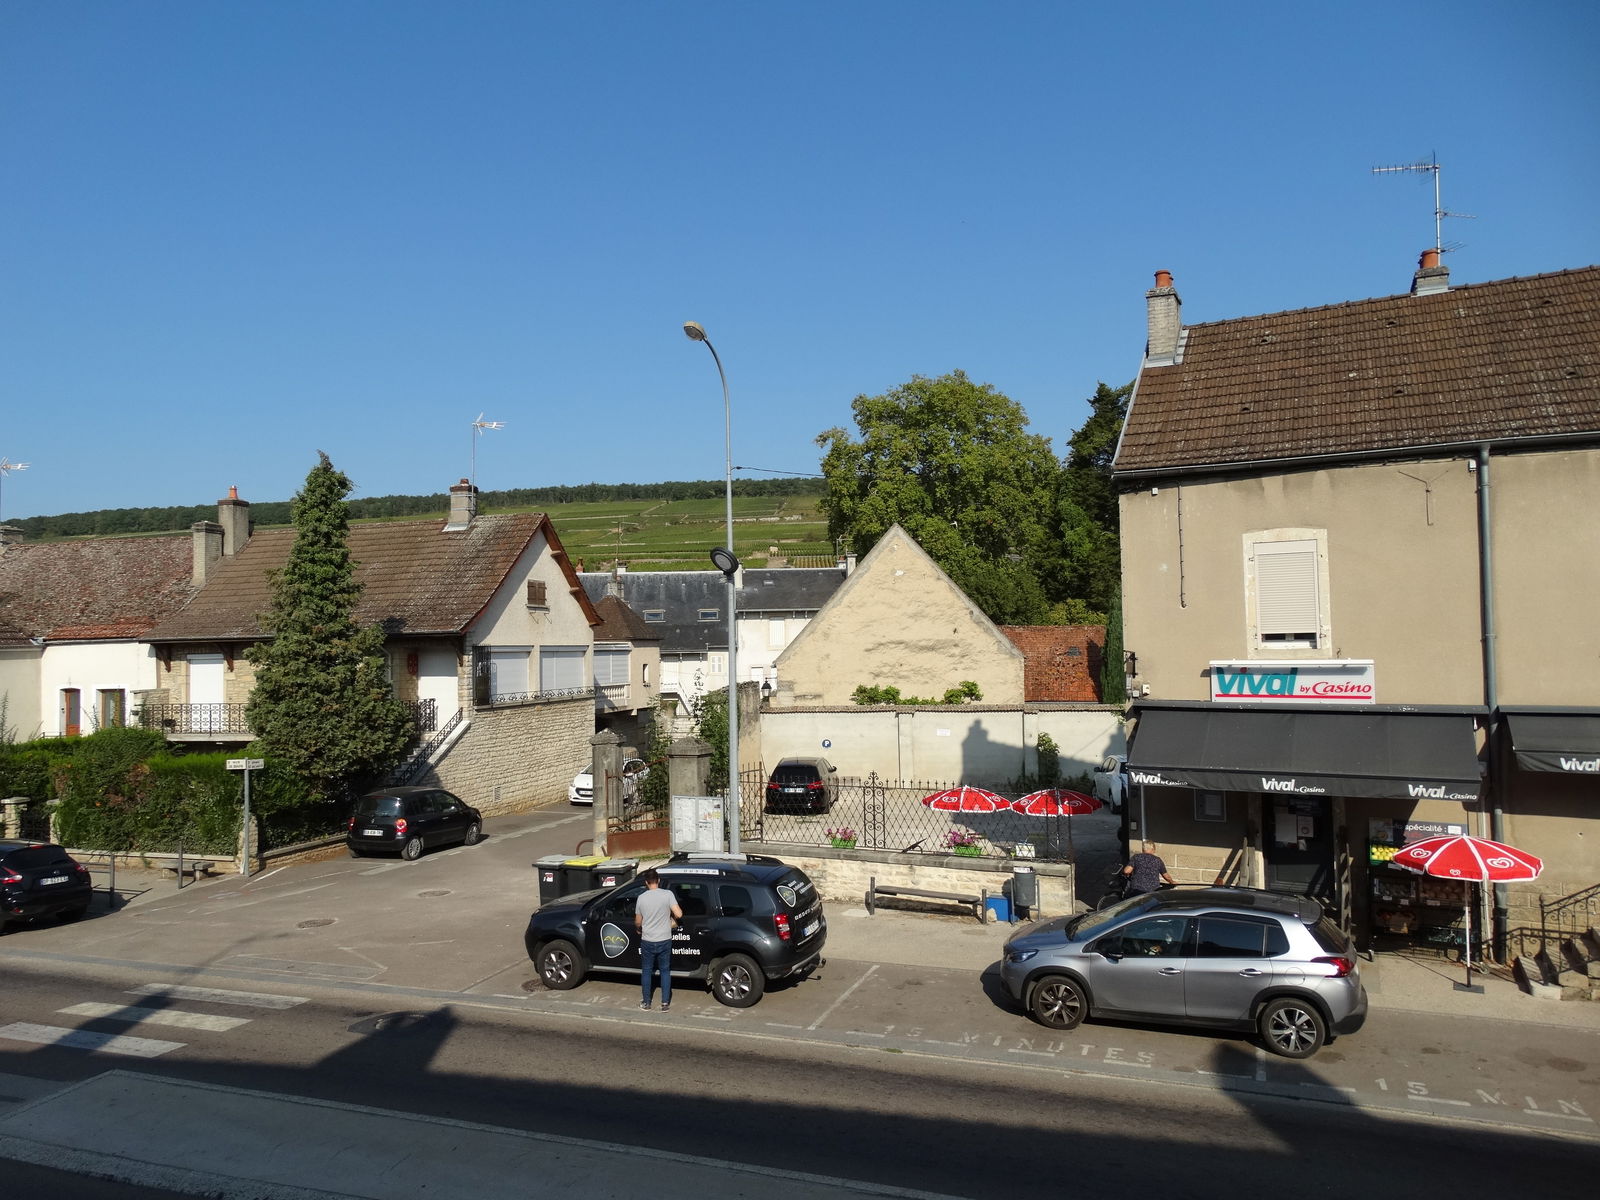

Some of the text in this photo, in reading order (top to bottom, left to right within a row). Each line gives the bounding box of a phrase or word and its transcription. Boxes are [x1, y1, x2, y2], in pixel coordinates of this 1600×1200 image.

[1216, 667, 1372, 696] Vival by Casino
[1560, 757, 1600, 771] Vival
[1261, 777, 1295, 791] Vival
[1300, 785, 1326, 793] Casino
[1408, 784, 1446, 798] Vival
[1375, 1078, 1428, 1095] 15
